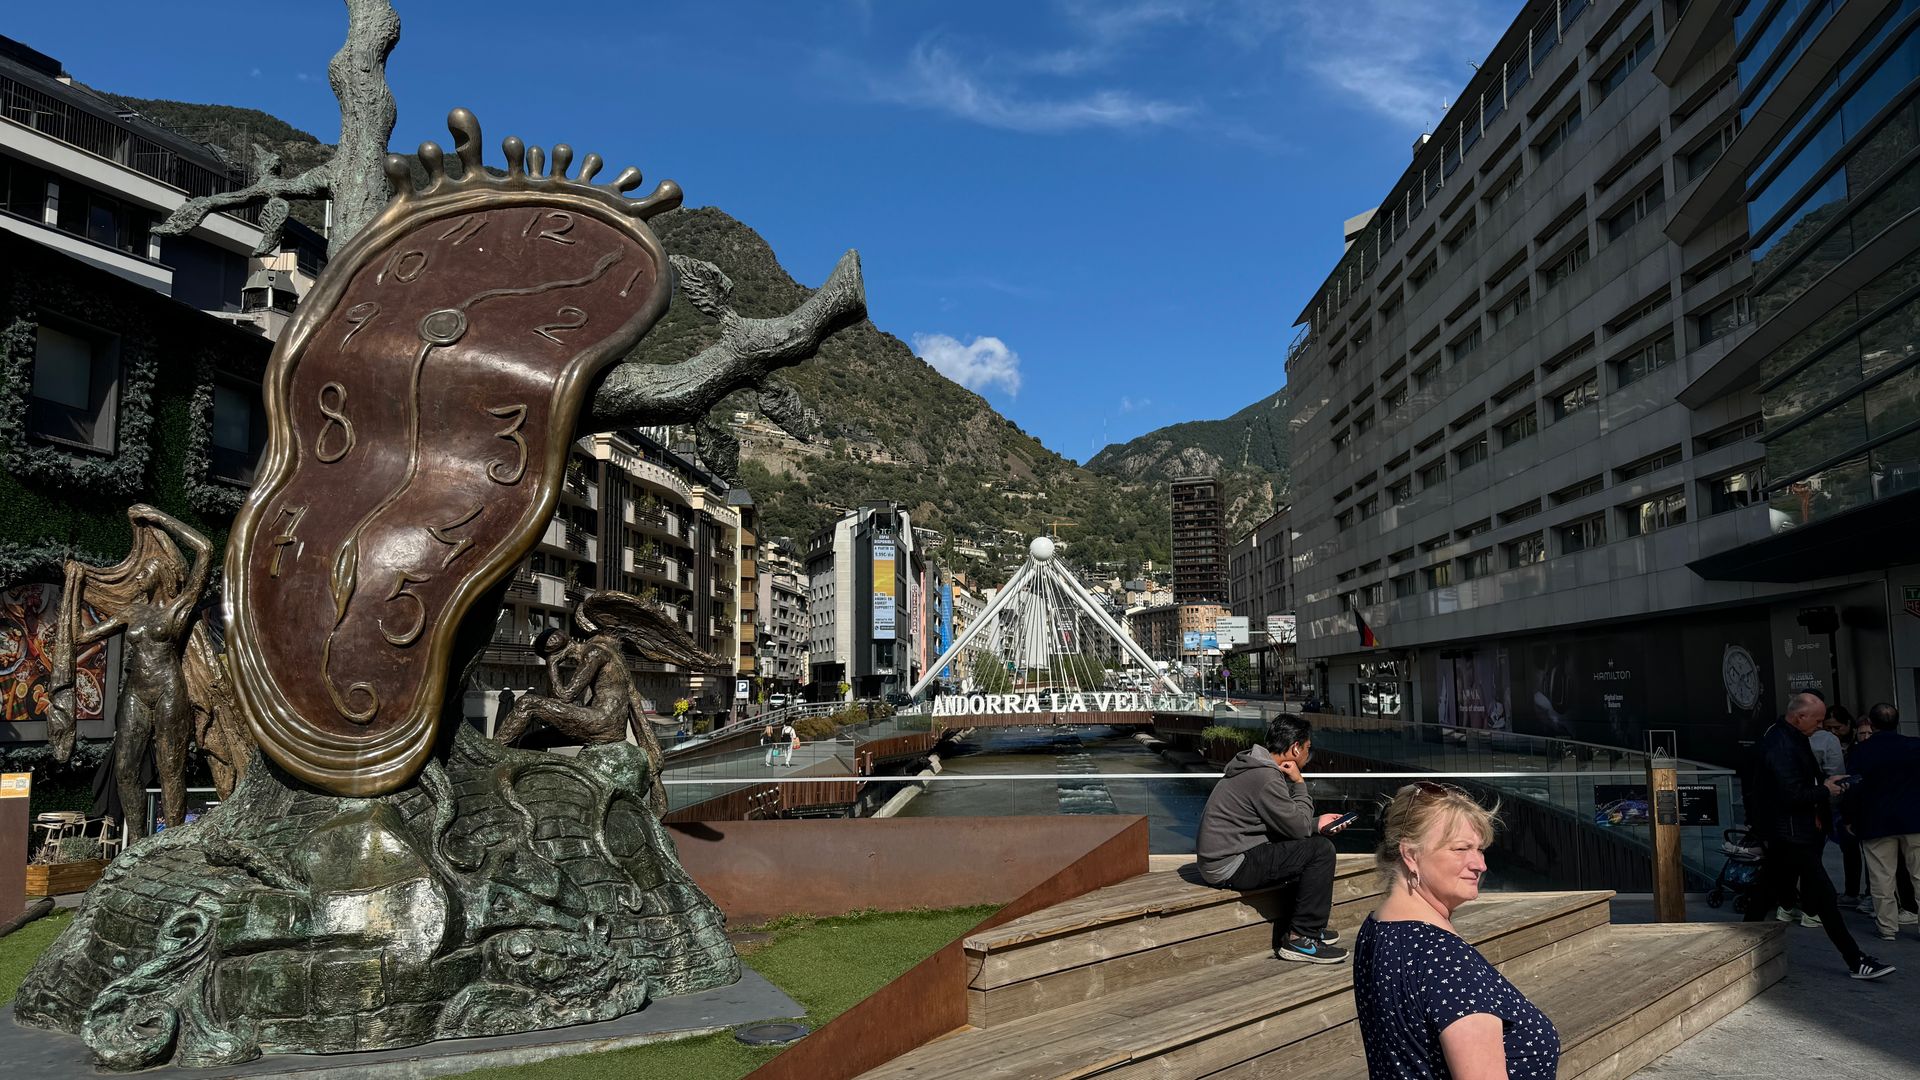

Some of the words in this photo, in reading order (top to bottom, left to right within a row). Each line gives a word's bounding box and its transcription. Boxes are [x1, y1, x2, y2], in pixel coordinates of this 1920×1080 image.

[438, 215, 489, 246] 11
[522, 211, 576, 244] 12
[375, 250, 429, 286] 10
[339, 301, 382, 352] 9
[534, 307, 589, 345] 2
[313, 382, 357, 464] 8
[486, 403, 528, 486] 3
[378, 570, 431, 647] 5
[738, 682, 747, 692] P
[1592, 671, 1632, 680] HAMILTON
[932, 692, 1042, 717] ANDORRA
[1050, 692, 1088, 713] LA
